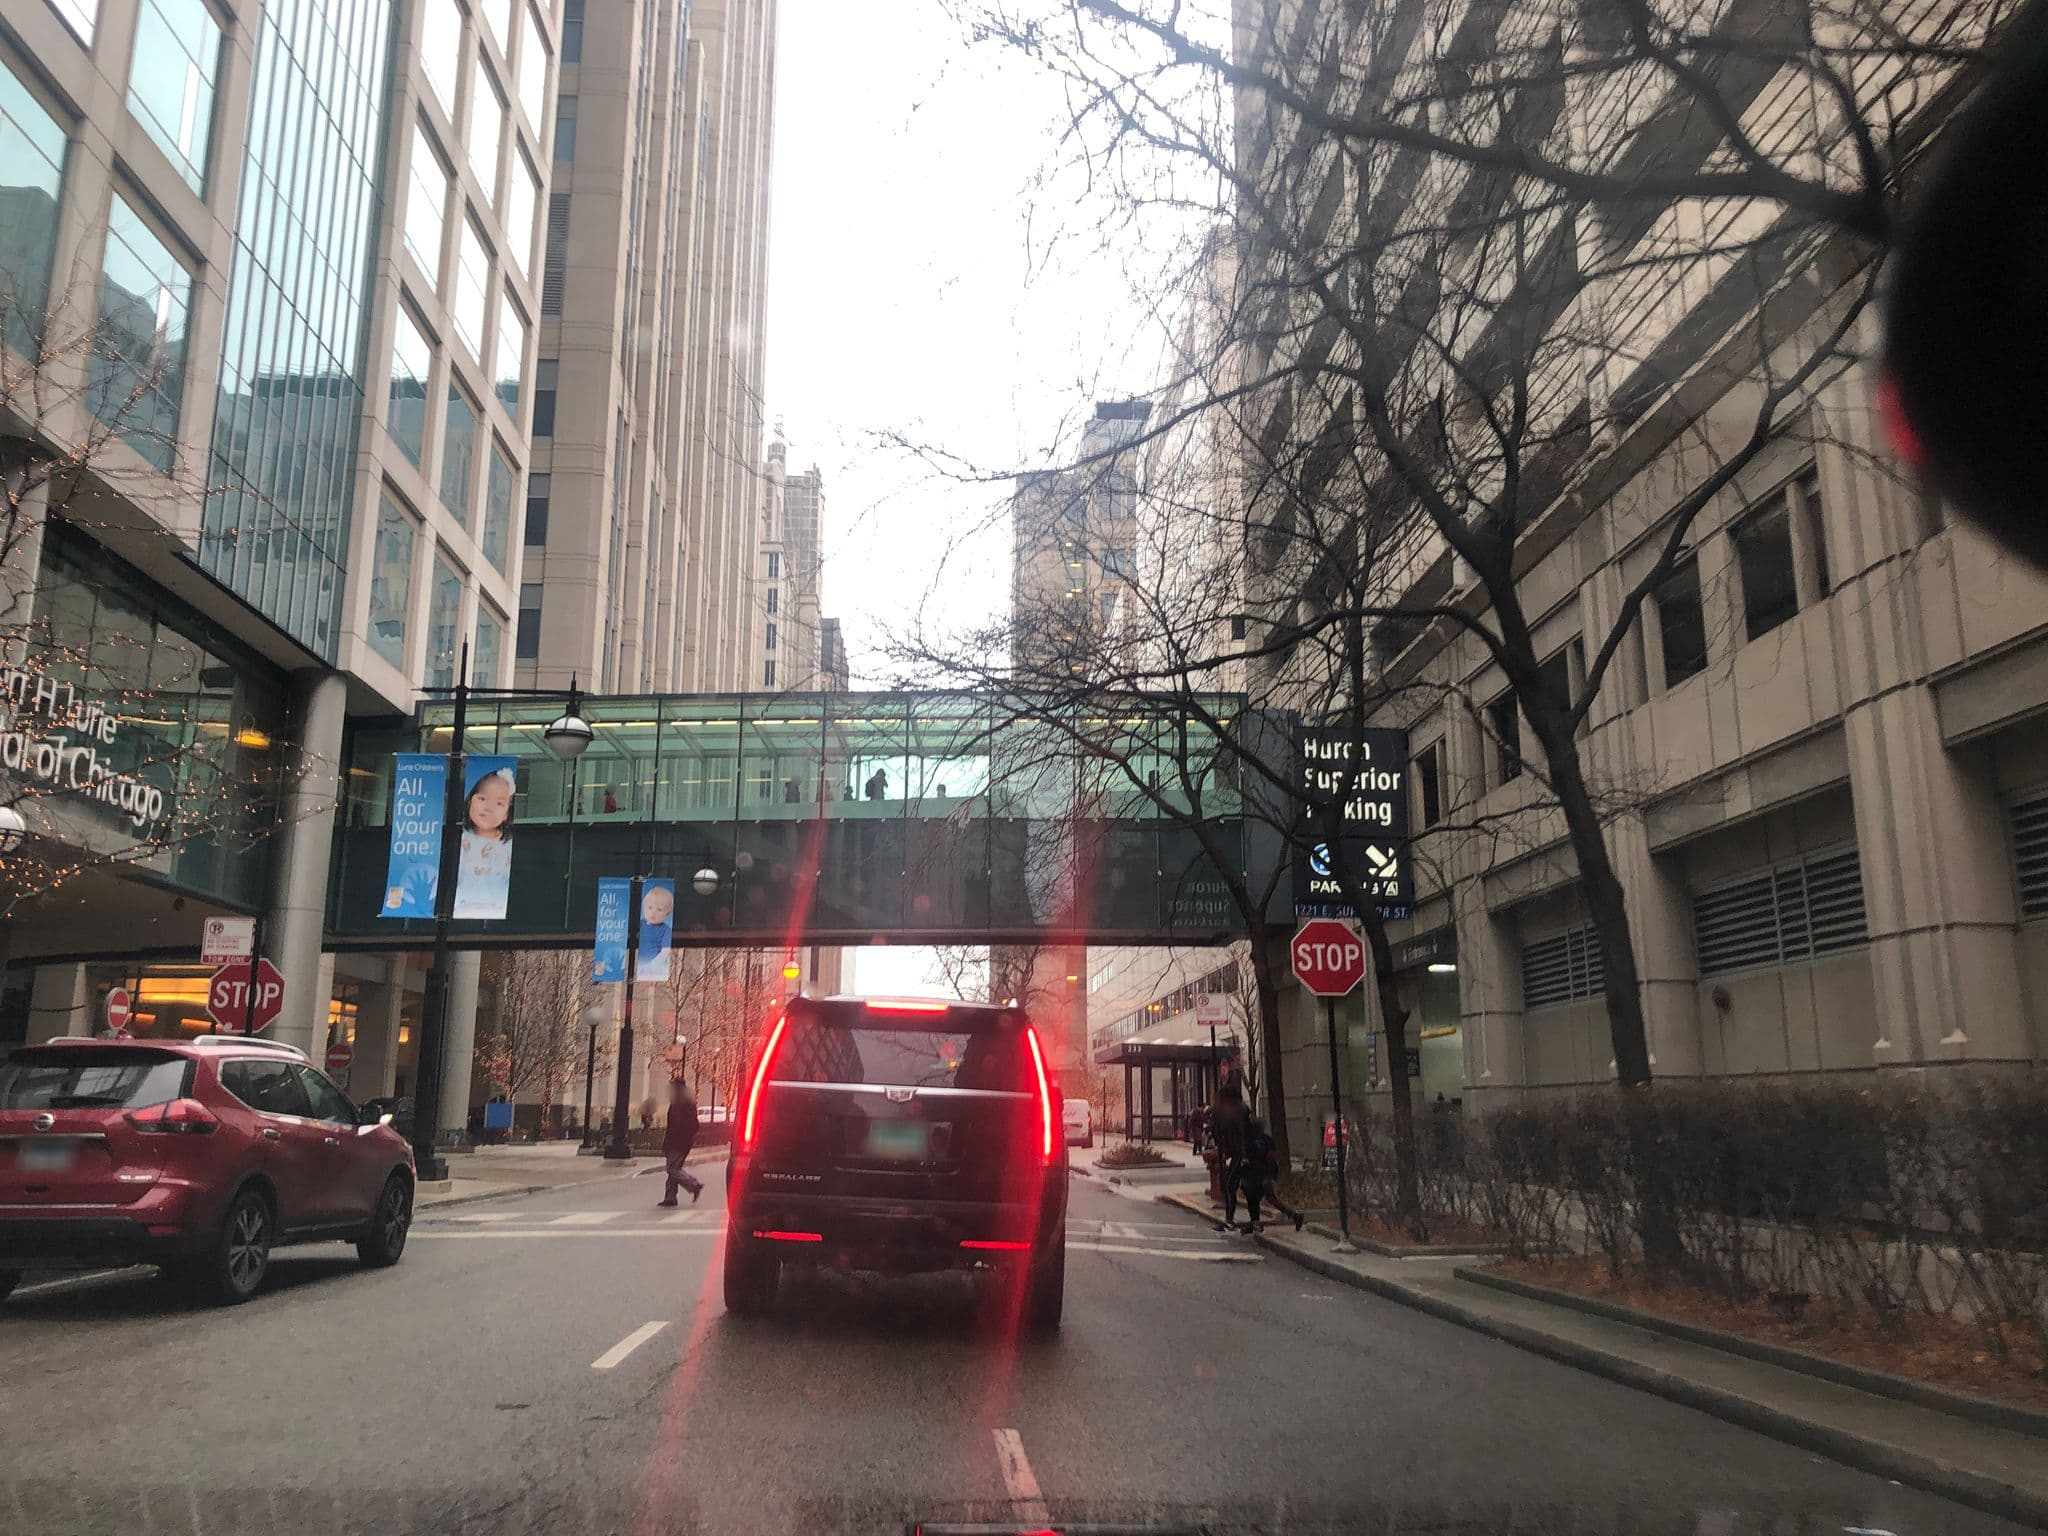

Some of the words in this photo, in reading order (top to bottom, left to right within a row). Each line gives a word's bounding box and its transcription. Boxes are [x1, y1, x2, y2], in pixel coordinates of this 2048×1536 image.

[70, 746, 162, 826] Chicago
[397, 777, 428, 798] All,
[1304, 766, 1400, 794] Suprior
[396, 798, 425, 817] for
[395, 819, 439, 839] your
[394, 839, 433, 855] one.
[600, 907, 618, 918] for
[599, 919, 625, 931] your
[1297, 943, 1360, 972] STOP
[213, 981, 280, 1009] STOP
